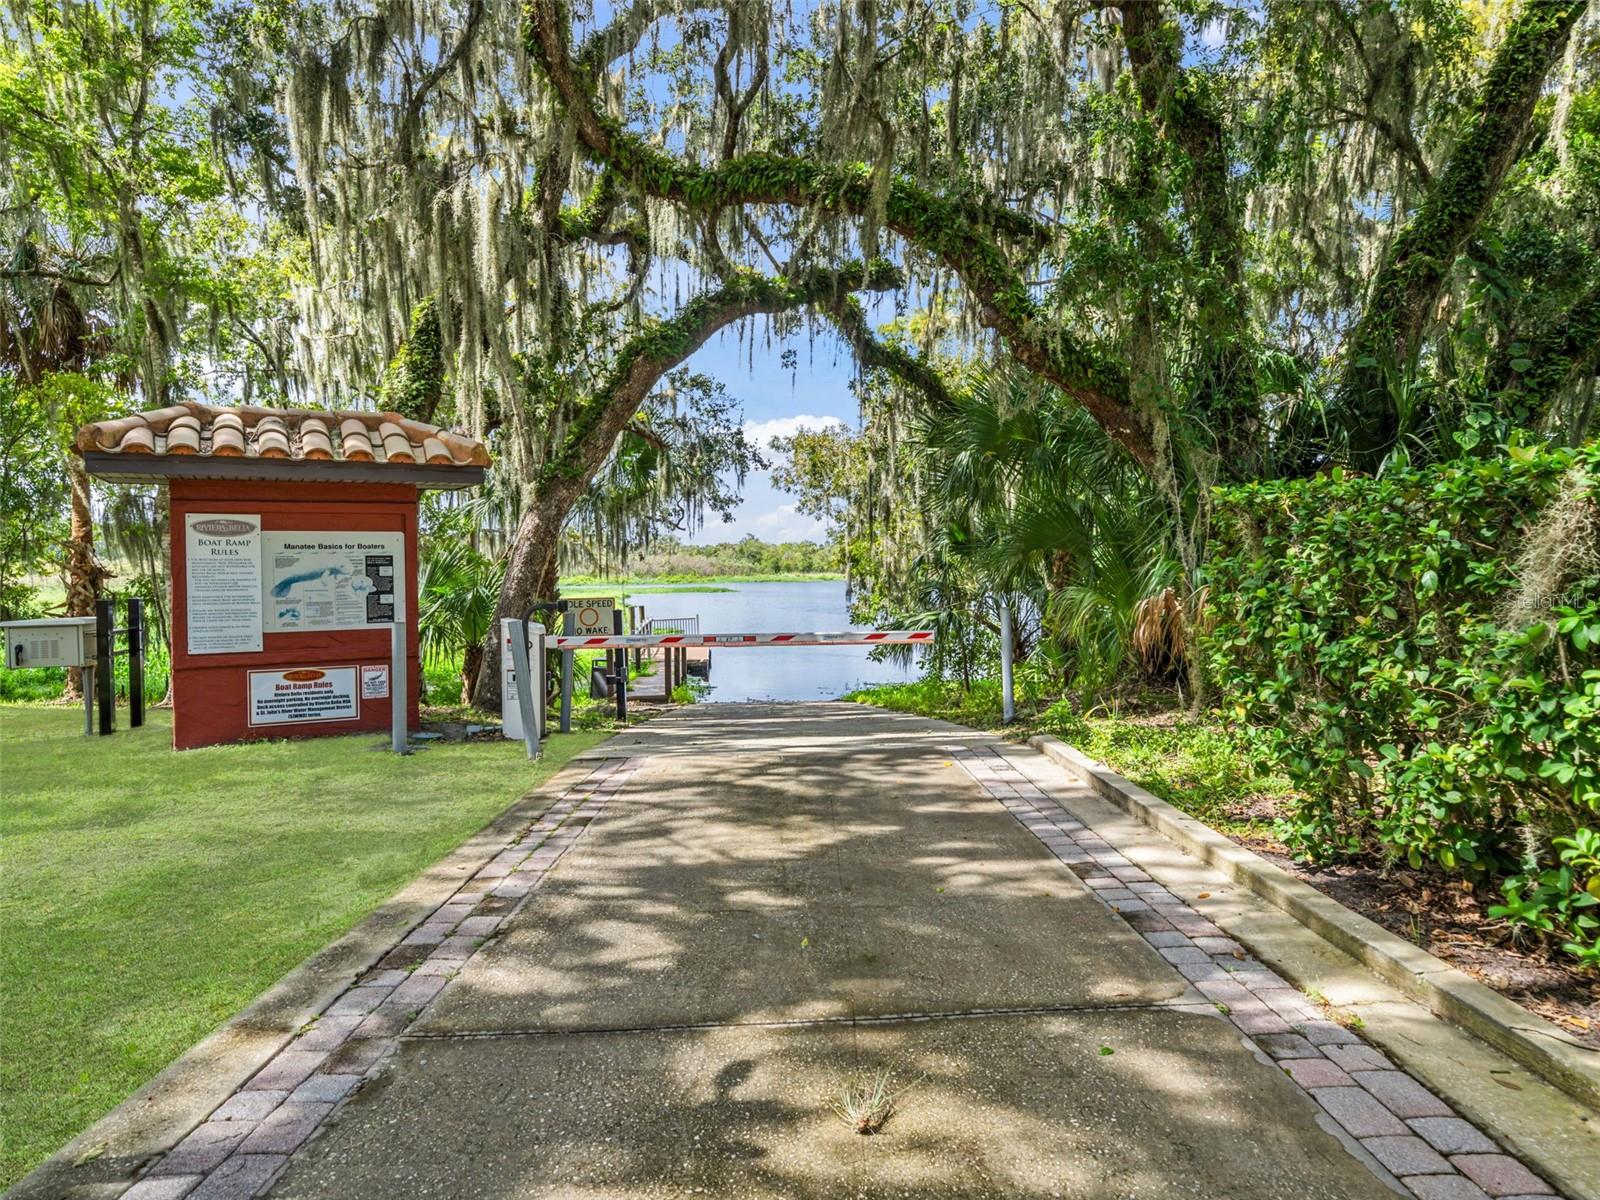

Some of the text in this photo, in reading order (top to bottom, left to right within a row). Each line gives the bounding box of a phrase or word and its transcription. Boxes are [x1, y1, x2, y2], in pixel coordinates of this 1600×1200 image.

[586, 600, 612, 608] SPEED
[275, 683, 291, 691] Boat
[293, 682, 312, 691] Ramp
